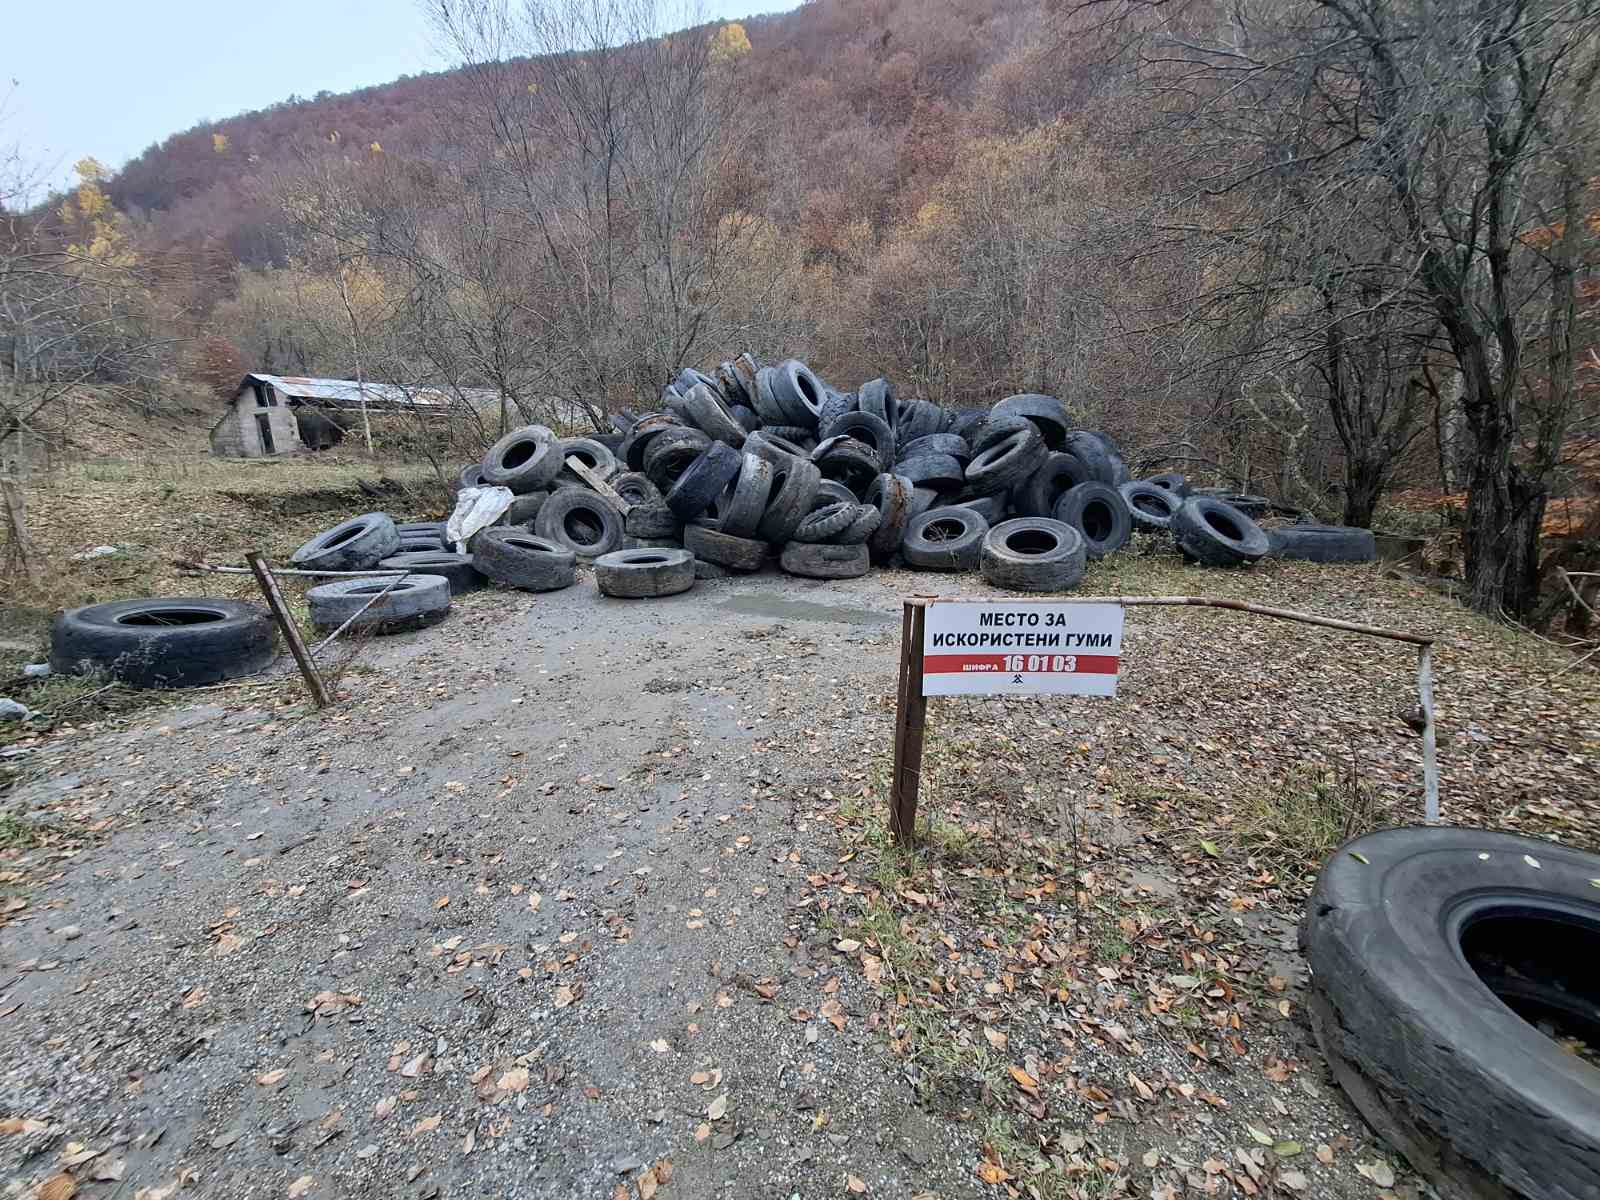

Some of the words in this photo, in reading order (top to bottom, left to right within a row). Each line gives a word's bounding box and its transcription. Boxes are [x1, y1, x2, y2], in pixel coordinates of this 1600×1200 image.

[979, 612, 1040, 626] МЕСТО
[1045, 612, 1067, 627] ЗА
[933, 632, 1060, 647] ИСКОРИСТЕНИ
[1065, 633, 1113, 648] ГУМИ
[962, 663, 999, 672] ШИФРА
[1003, 655, 1025, 672] 16
[1027, 655, 1049, 672] 01
[1052, 655, 1077, 672] 03
